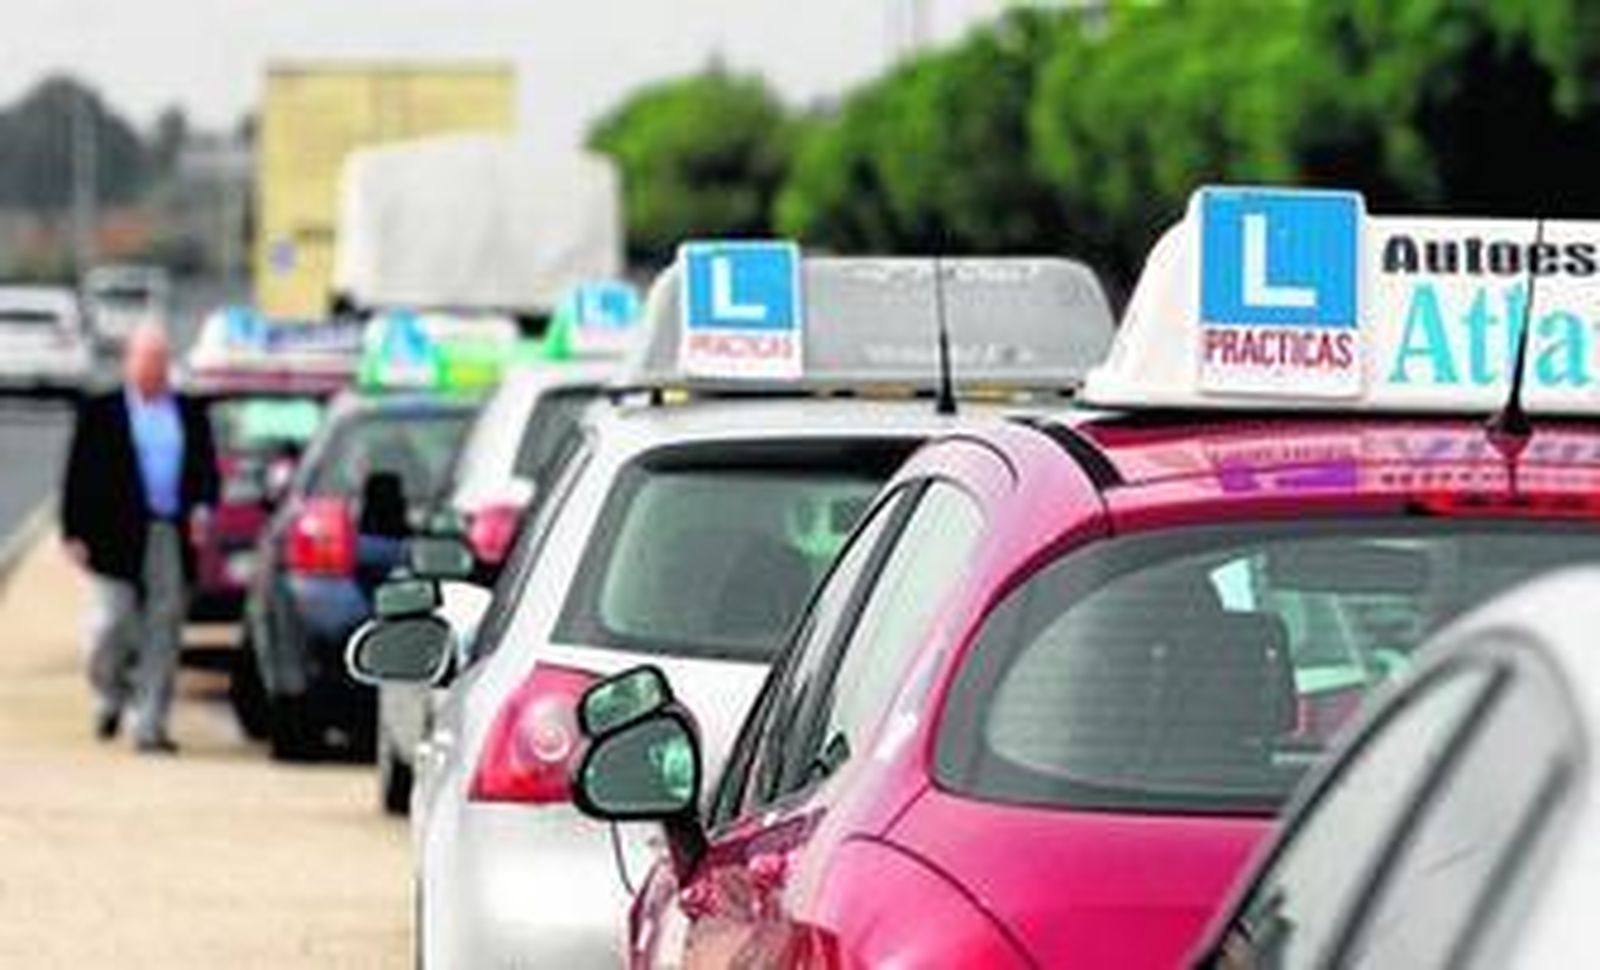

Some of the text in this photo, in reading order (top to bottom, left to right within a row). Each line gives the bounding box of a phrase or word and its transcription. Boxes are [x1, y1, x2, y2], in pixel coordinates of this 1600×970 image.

[711, 257, 767, 319] L
[1243, 213, 1318, 307] L
[1204, 328, 1353, 370] PRACTICAS
[1387, 281, 1600, 386] Atla
